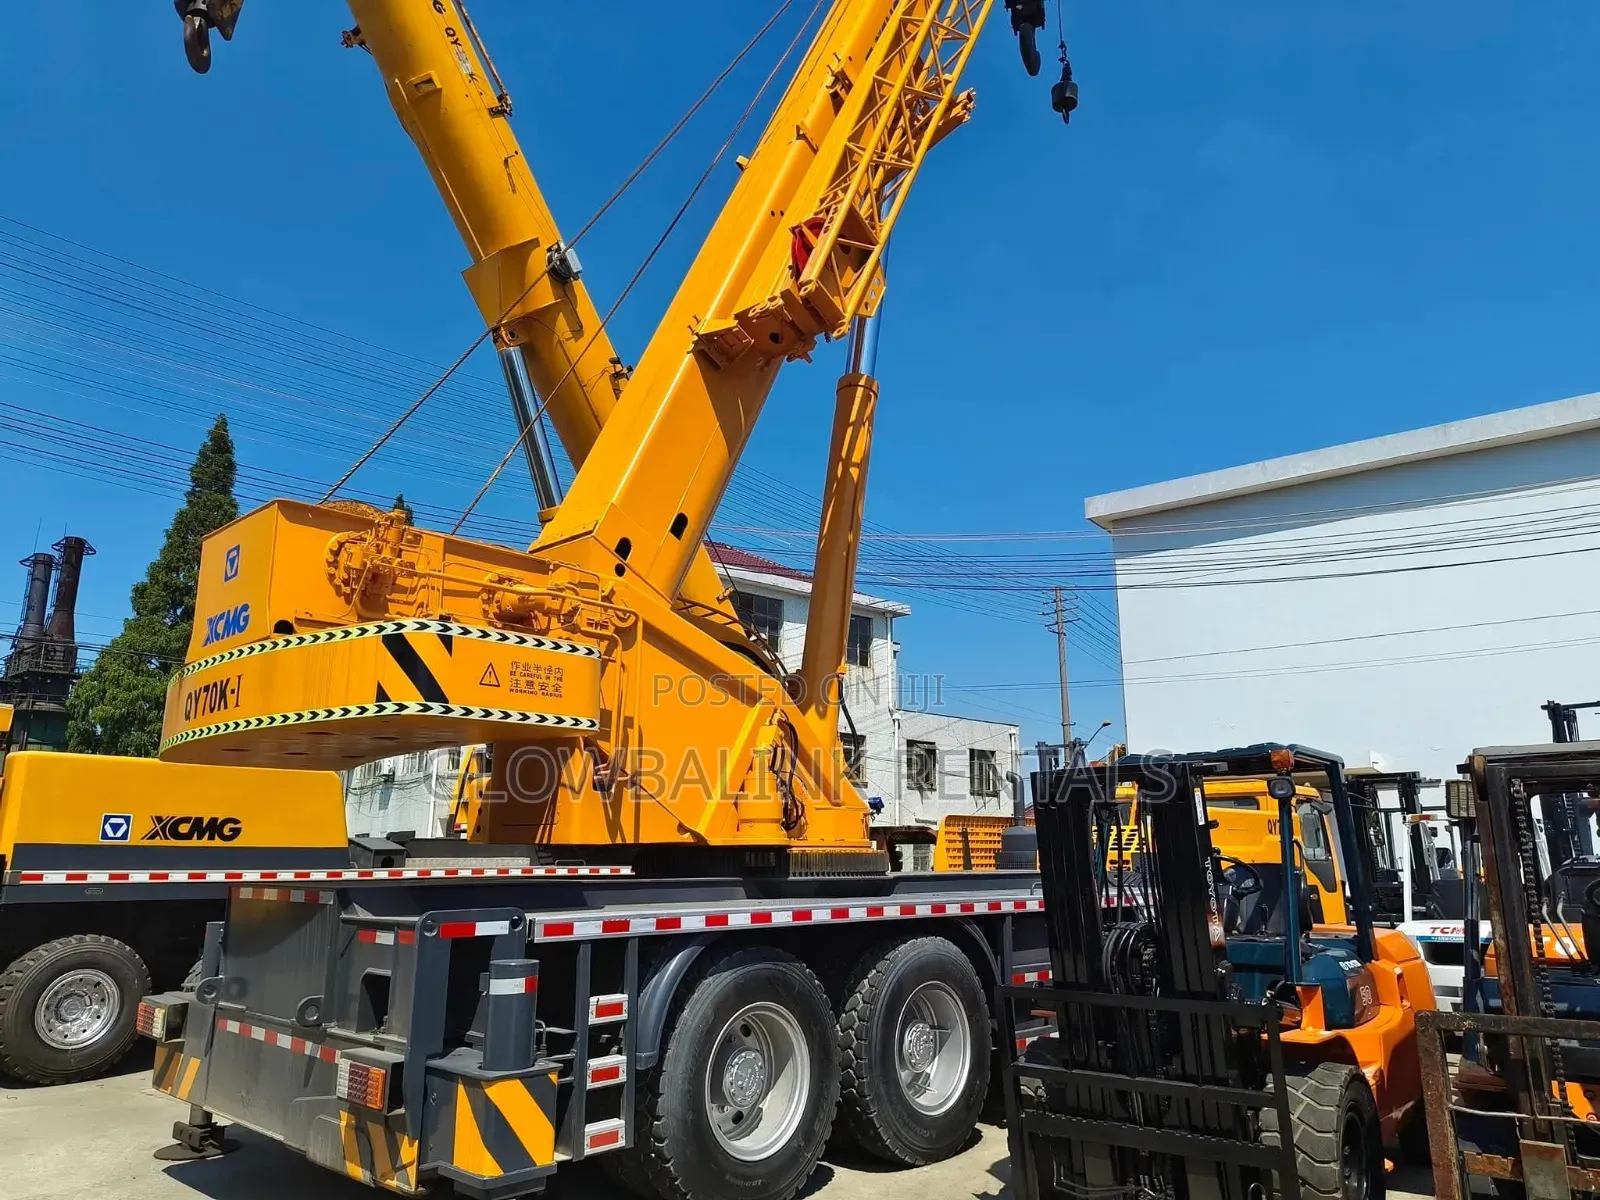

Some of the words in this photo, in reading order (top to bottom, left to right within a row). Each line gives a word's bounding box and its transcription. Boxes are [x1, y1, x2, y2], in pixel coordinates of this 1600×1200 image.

[202, 603, 250, 647] XCMG
[510, 660, 563, 676] 作业半径内
[519, 671, 543, 680] CAREFUL
[509, 677, 562, 692] 注意安全
[140, 815, 243, 842] XCMG
[1204, 856, 1221, 941] TOYOTA
